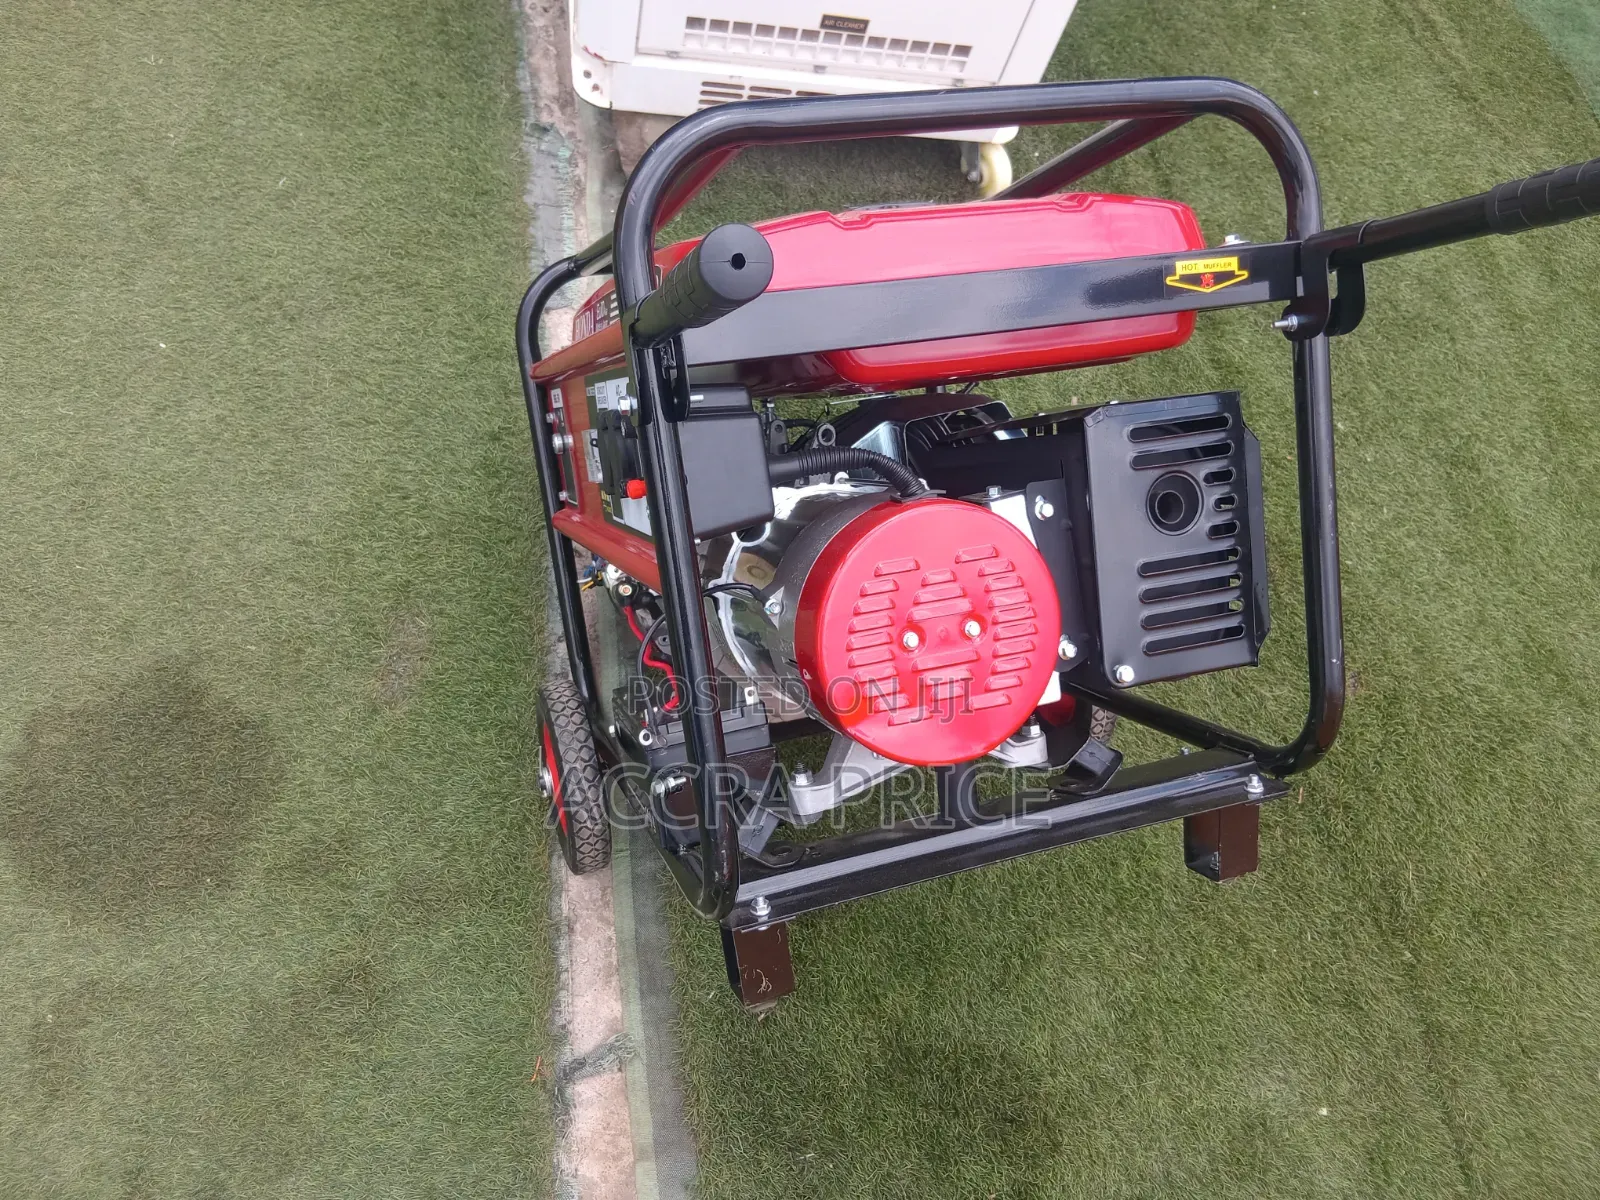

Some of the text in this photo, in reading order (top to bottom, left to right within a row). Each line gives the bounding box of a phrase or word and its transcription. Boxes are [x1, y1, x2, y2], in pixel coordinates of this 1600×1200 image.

[823, 19, 866, 30] AIR CLEANER
[1181, 261, 1232, 272] HOT MUFFLER
